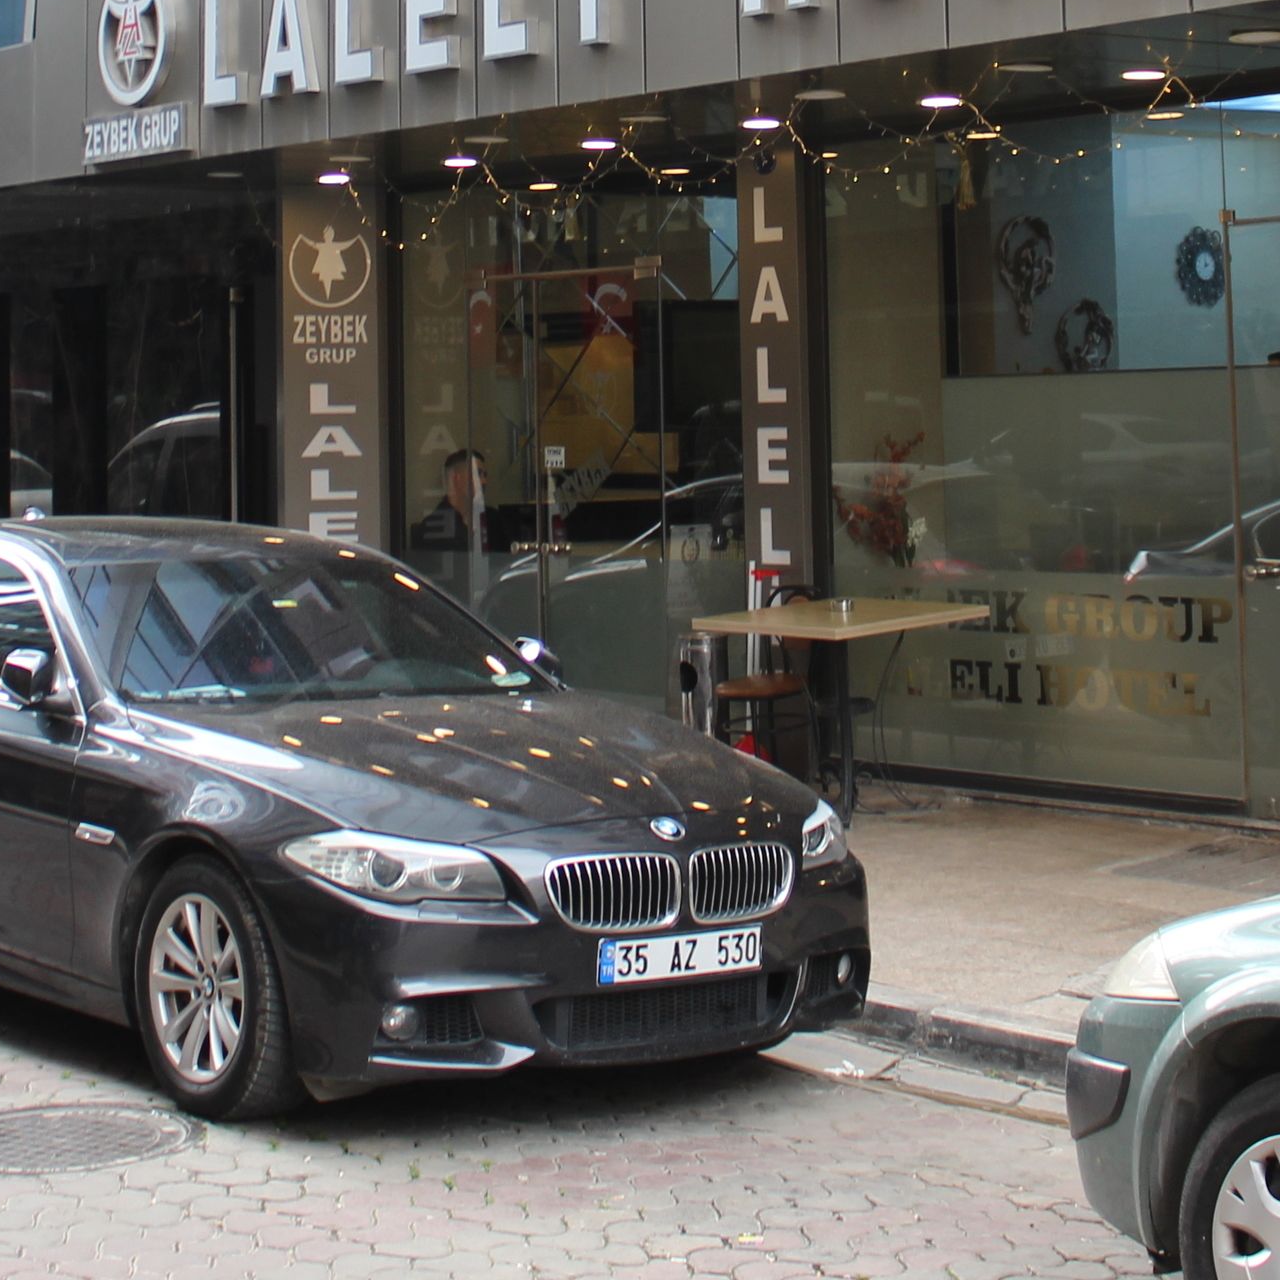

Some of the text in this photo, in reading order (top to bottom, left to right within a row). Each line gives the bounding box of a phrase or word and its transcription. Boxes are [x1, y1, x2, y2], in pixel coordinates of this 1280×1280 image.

[84, 109, 180, 158] ZEYBEK GRUP
[292, 315, 369, 345] ZEYBEK
[305, 347, 357, 364] GRUP
[1043, 591, 1235, 644] GROUP
[617, 943, 649, 977] 35
[669, 939, 698, 973] AZ
[717, 932, 758, 967] 530
